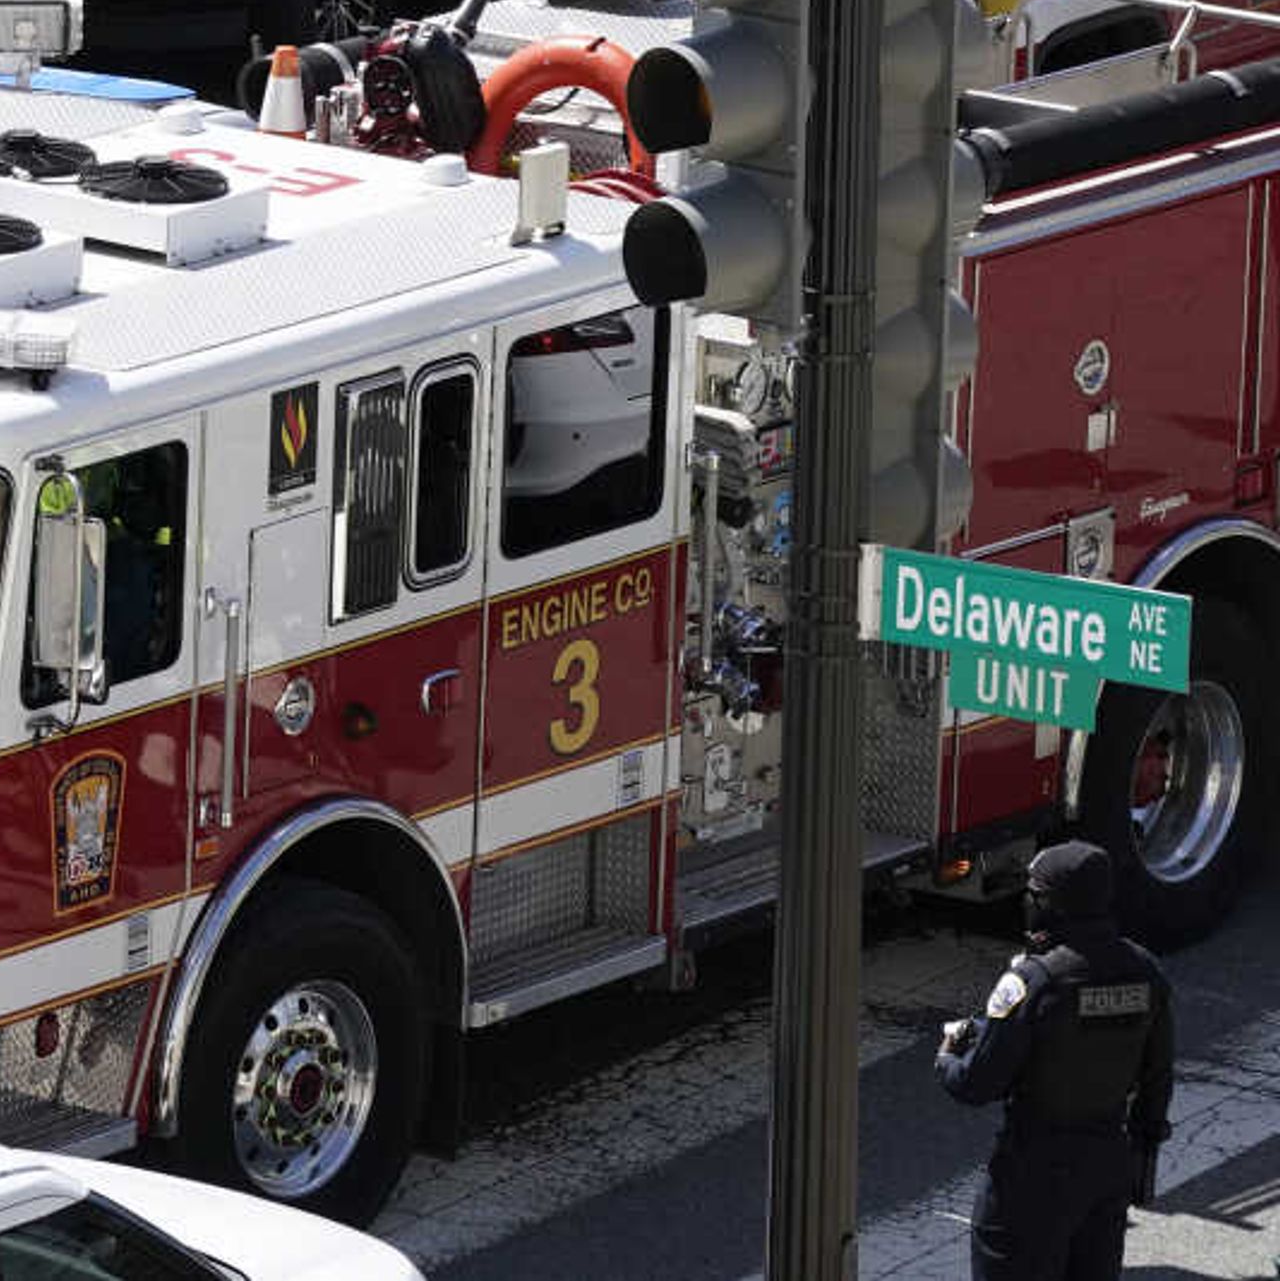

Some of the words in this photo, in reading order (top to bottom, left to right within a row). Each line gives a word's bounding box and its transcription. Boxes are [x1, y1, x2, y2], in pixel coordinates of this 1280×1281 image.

[502, 581, 608, 650] ENGINE
[895, 565, 1107, 661] Delaware
[1128, 602, 1167, 637] AVE
[977, 658, 1070, 717] UNIT
[1129, 640, 1163, 673] NE
[550, 638, 600, 755] 3
